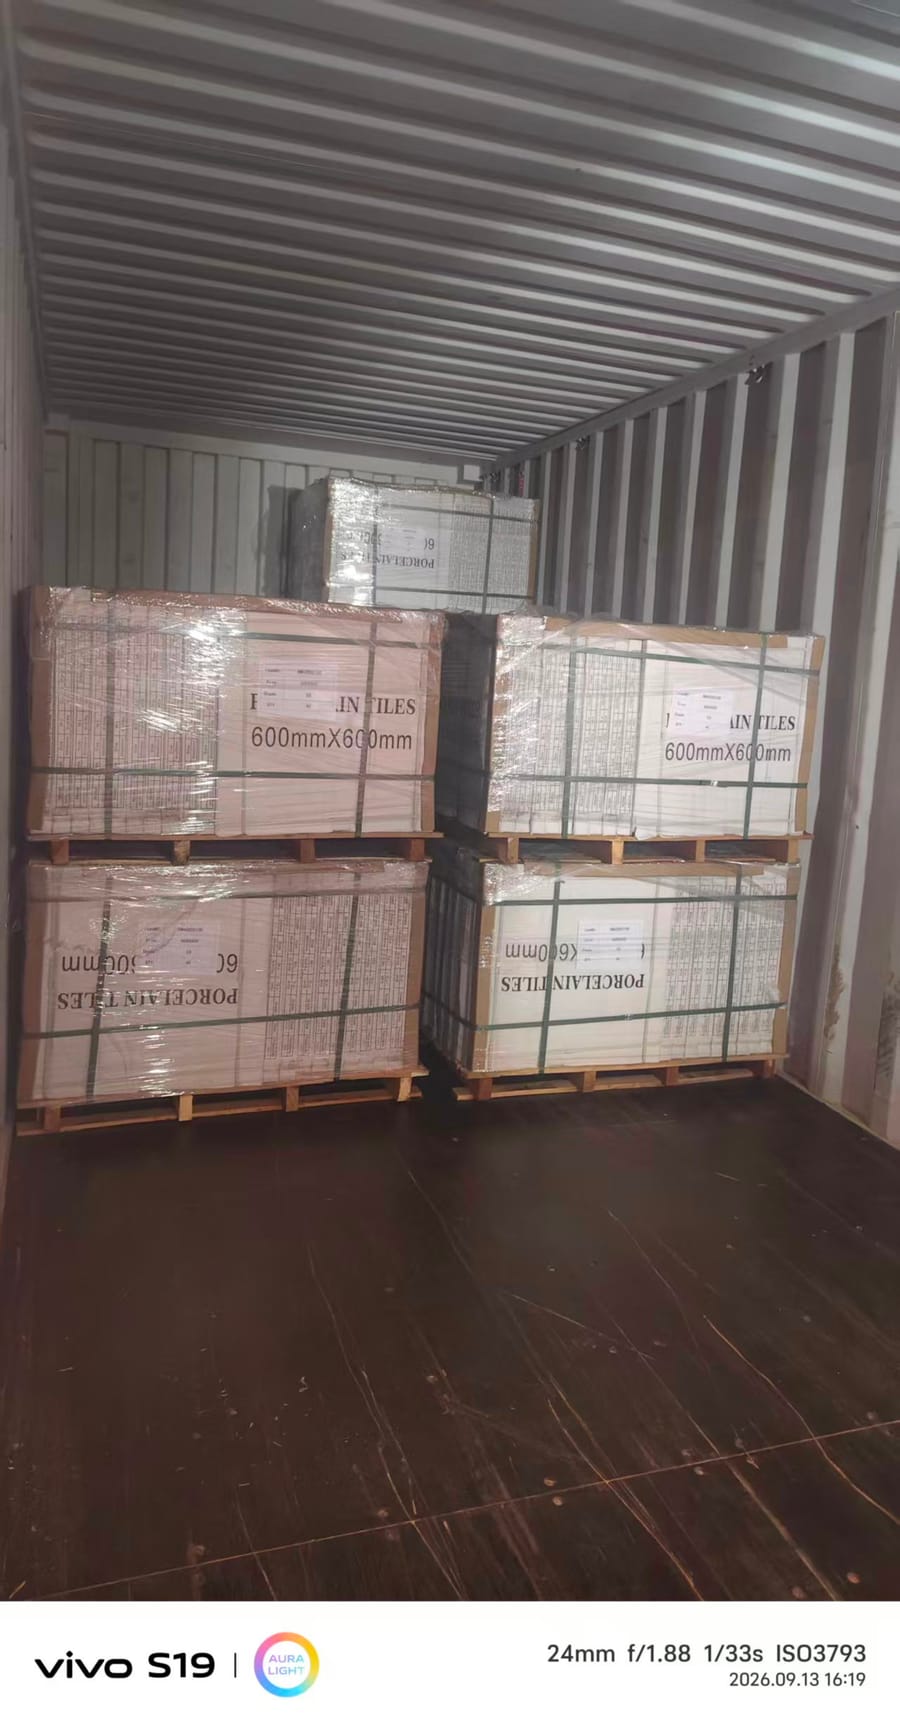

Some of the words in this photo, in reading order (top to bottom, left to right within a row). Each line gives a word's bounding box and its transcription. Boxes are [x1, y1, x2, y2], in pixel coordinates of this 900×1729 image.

[501, 975, 547, 993] TILES
[551, 974, 645, 991] PORCELAIN
[57, 991, 119, 1010] TLES
[125, 988, 238, 1008] PORCELAIN
